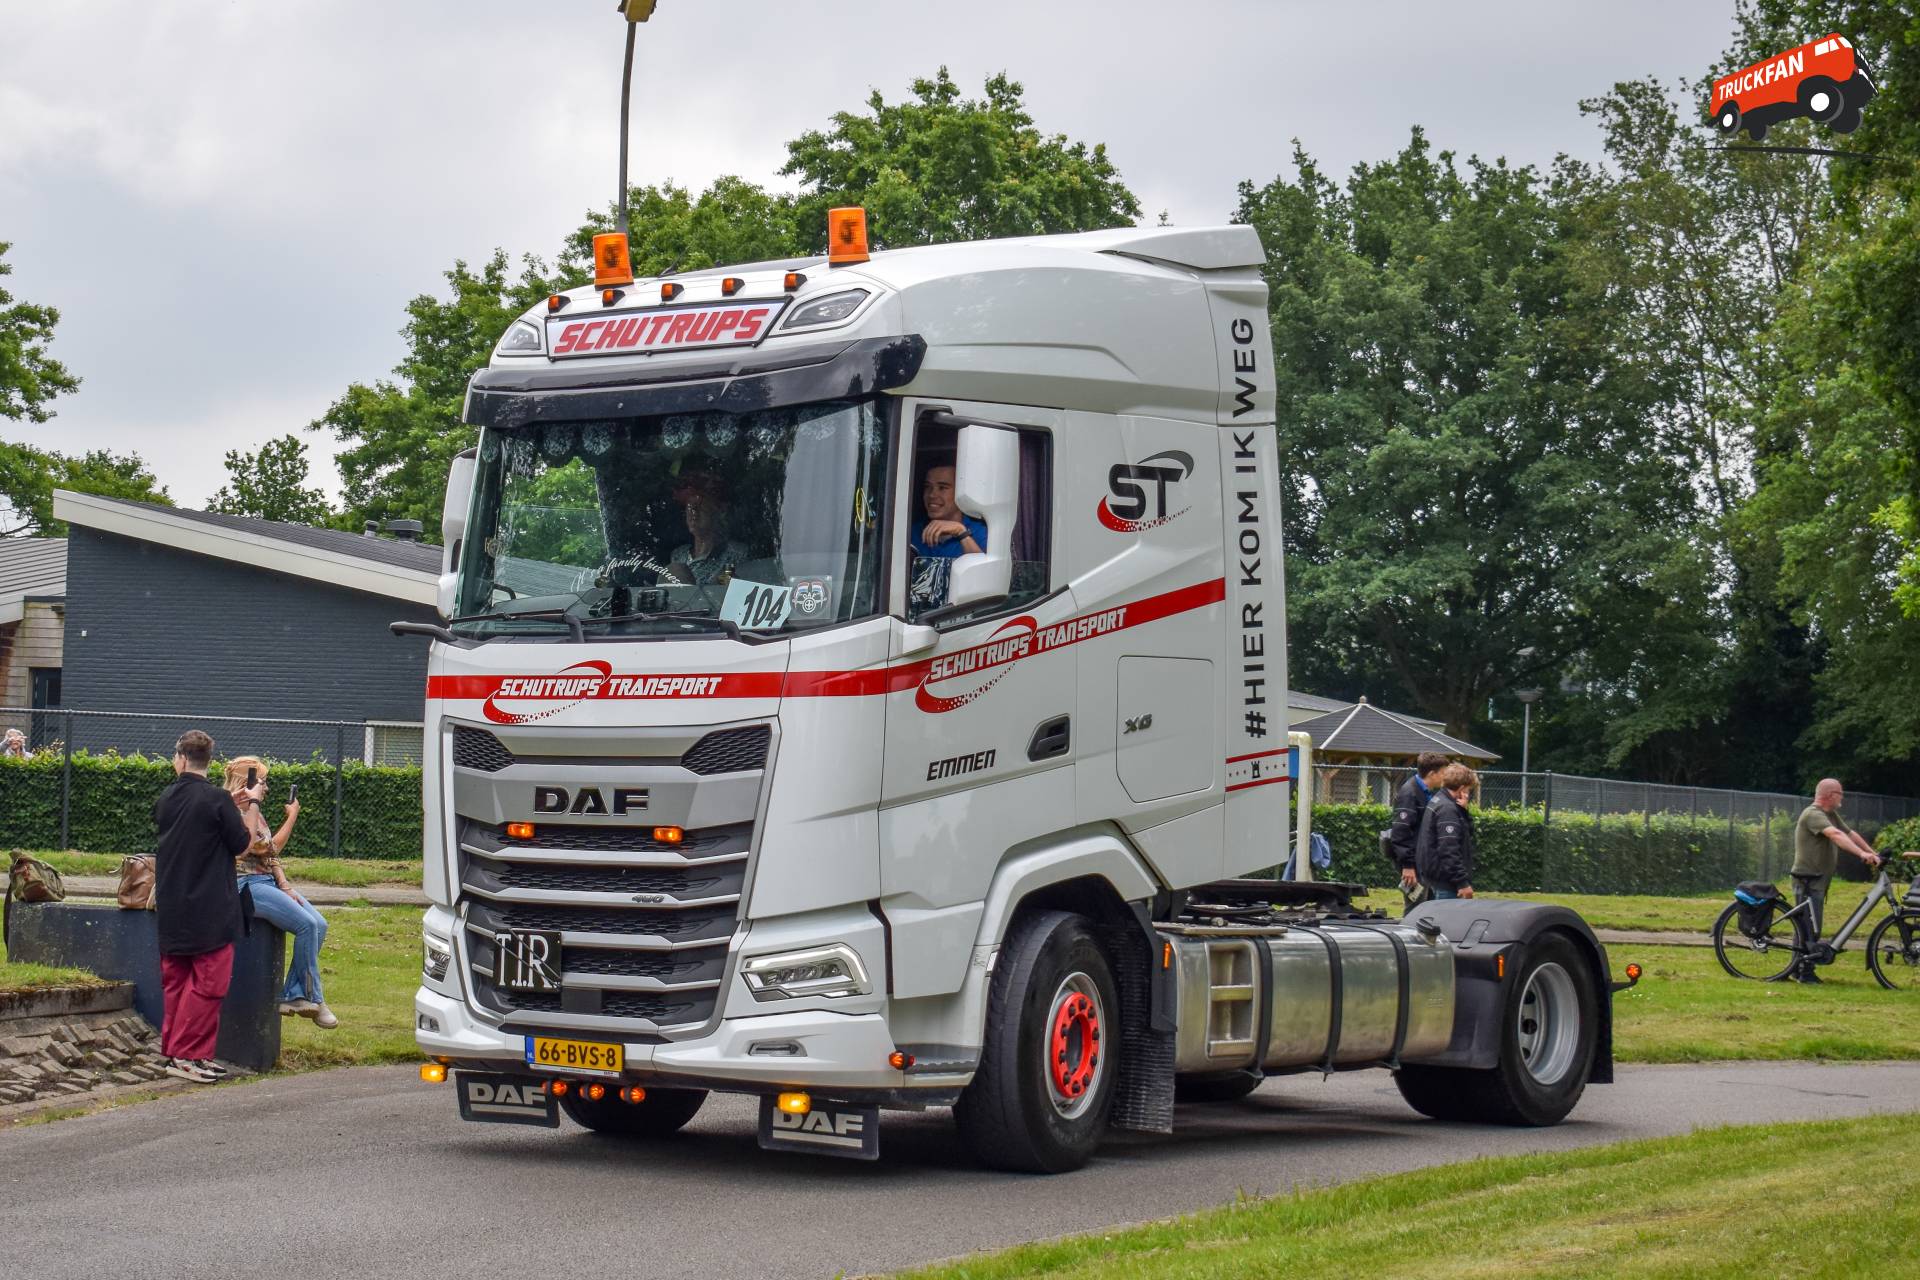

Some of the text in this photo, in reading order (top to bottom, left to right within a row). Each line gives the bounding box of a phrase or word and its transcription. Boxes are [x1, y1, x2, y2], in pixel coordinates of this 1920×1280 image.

[554, 308, 770, 353] SCHUTRUPS
[1231, 318, 1258, 418] WEG
[1108, 463, 1185, 521] ST
[1237, 491, 1262, 586] KOM
[602, 554, 643, 577] family
[741, 585, 788, 627] 104
[930, 608, 1127, 681] SCHUTRUPS TRANSPORT
[500, 676, 722, 697] SCHUTRUPS TRANSPORT
[1242, 601, 1267, 738] #HIER
[926, 749, 997, 782] EMMEN
[533, 784, 650, 817] DAF
[539, 1041, 617, 1067] 66-BVS-8
[468, 1082, 547, 1104] DAF
[773, 1106, 864, 1135] DAF
